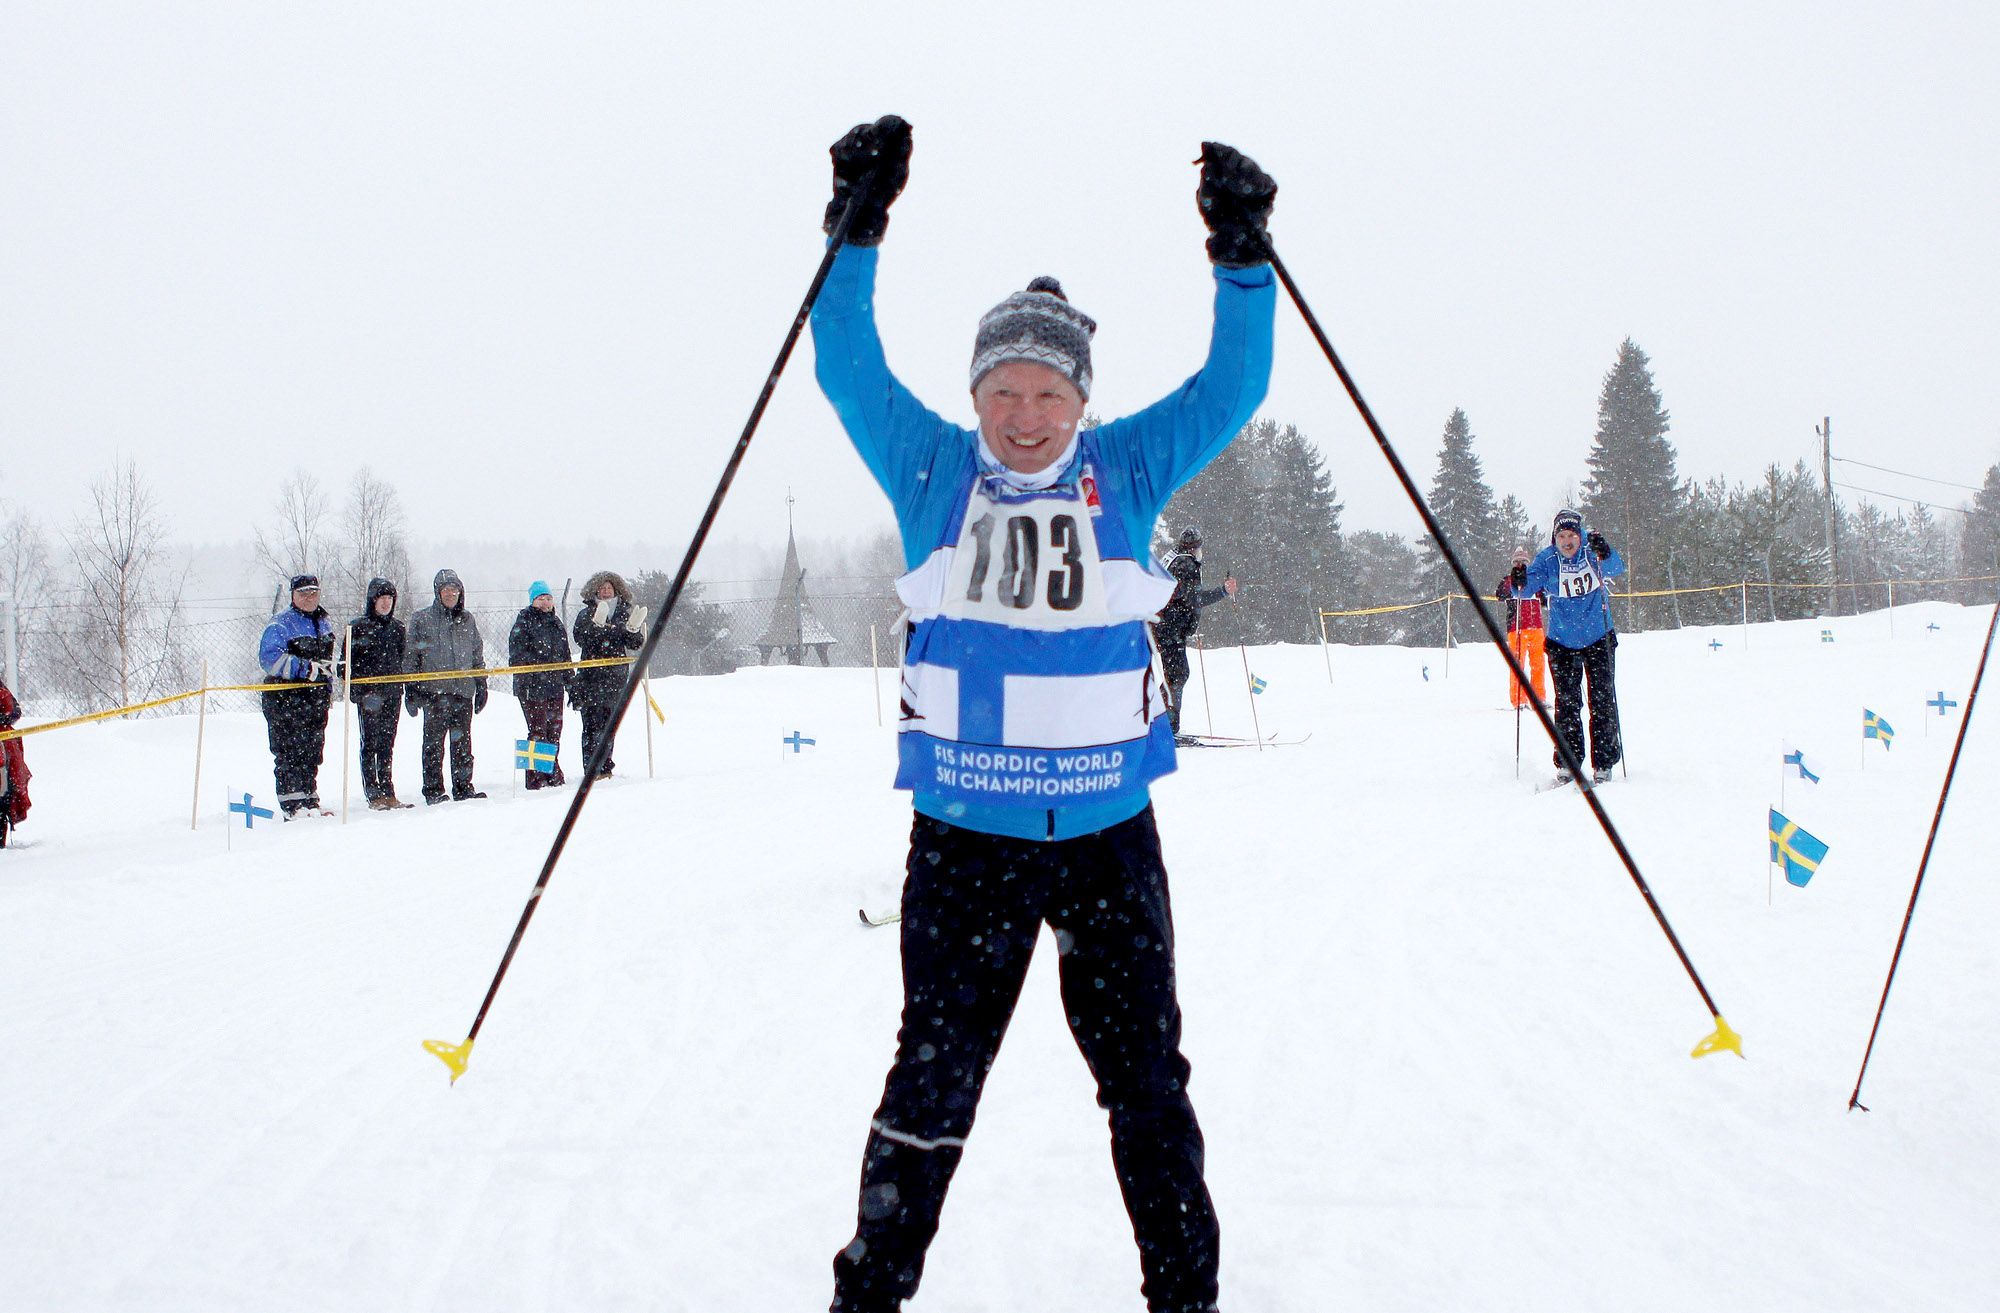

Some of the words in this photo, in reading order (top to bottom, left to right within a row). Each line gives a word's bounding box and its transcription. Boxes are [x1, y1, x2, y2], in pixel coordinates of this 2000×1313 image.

[966, 512, 1083, 611] 103
[1562, 572, 1593, 597] 132
[934, 744, 956, 765] FIS
[960, 751, 1048, 774] NORDIC
[1056, 750, 1124, 774] WORLD
[936, 765, 957, 786] SKI
[960, 771, 1122, 796] CHAMPIONSHIPS
